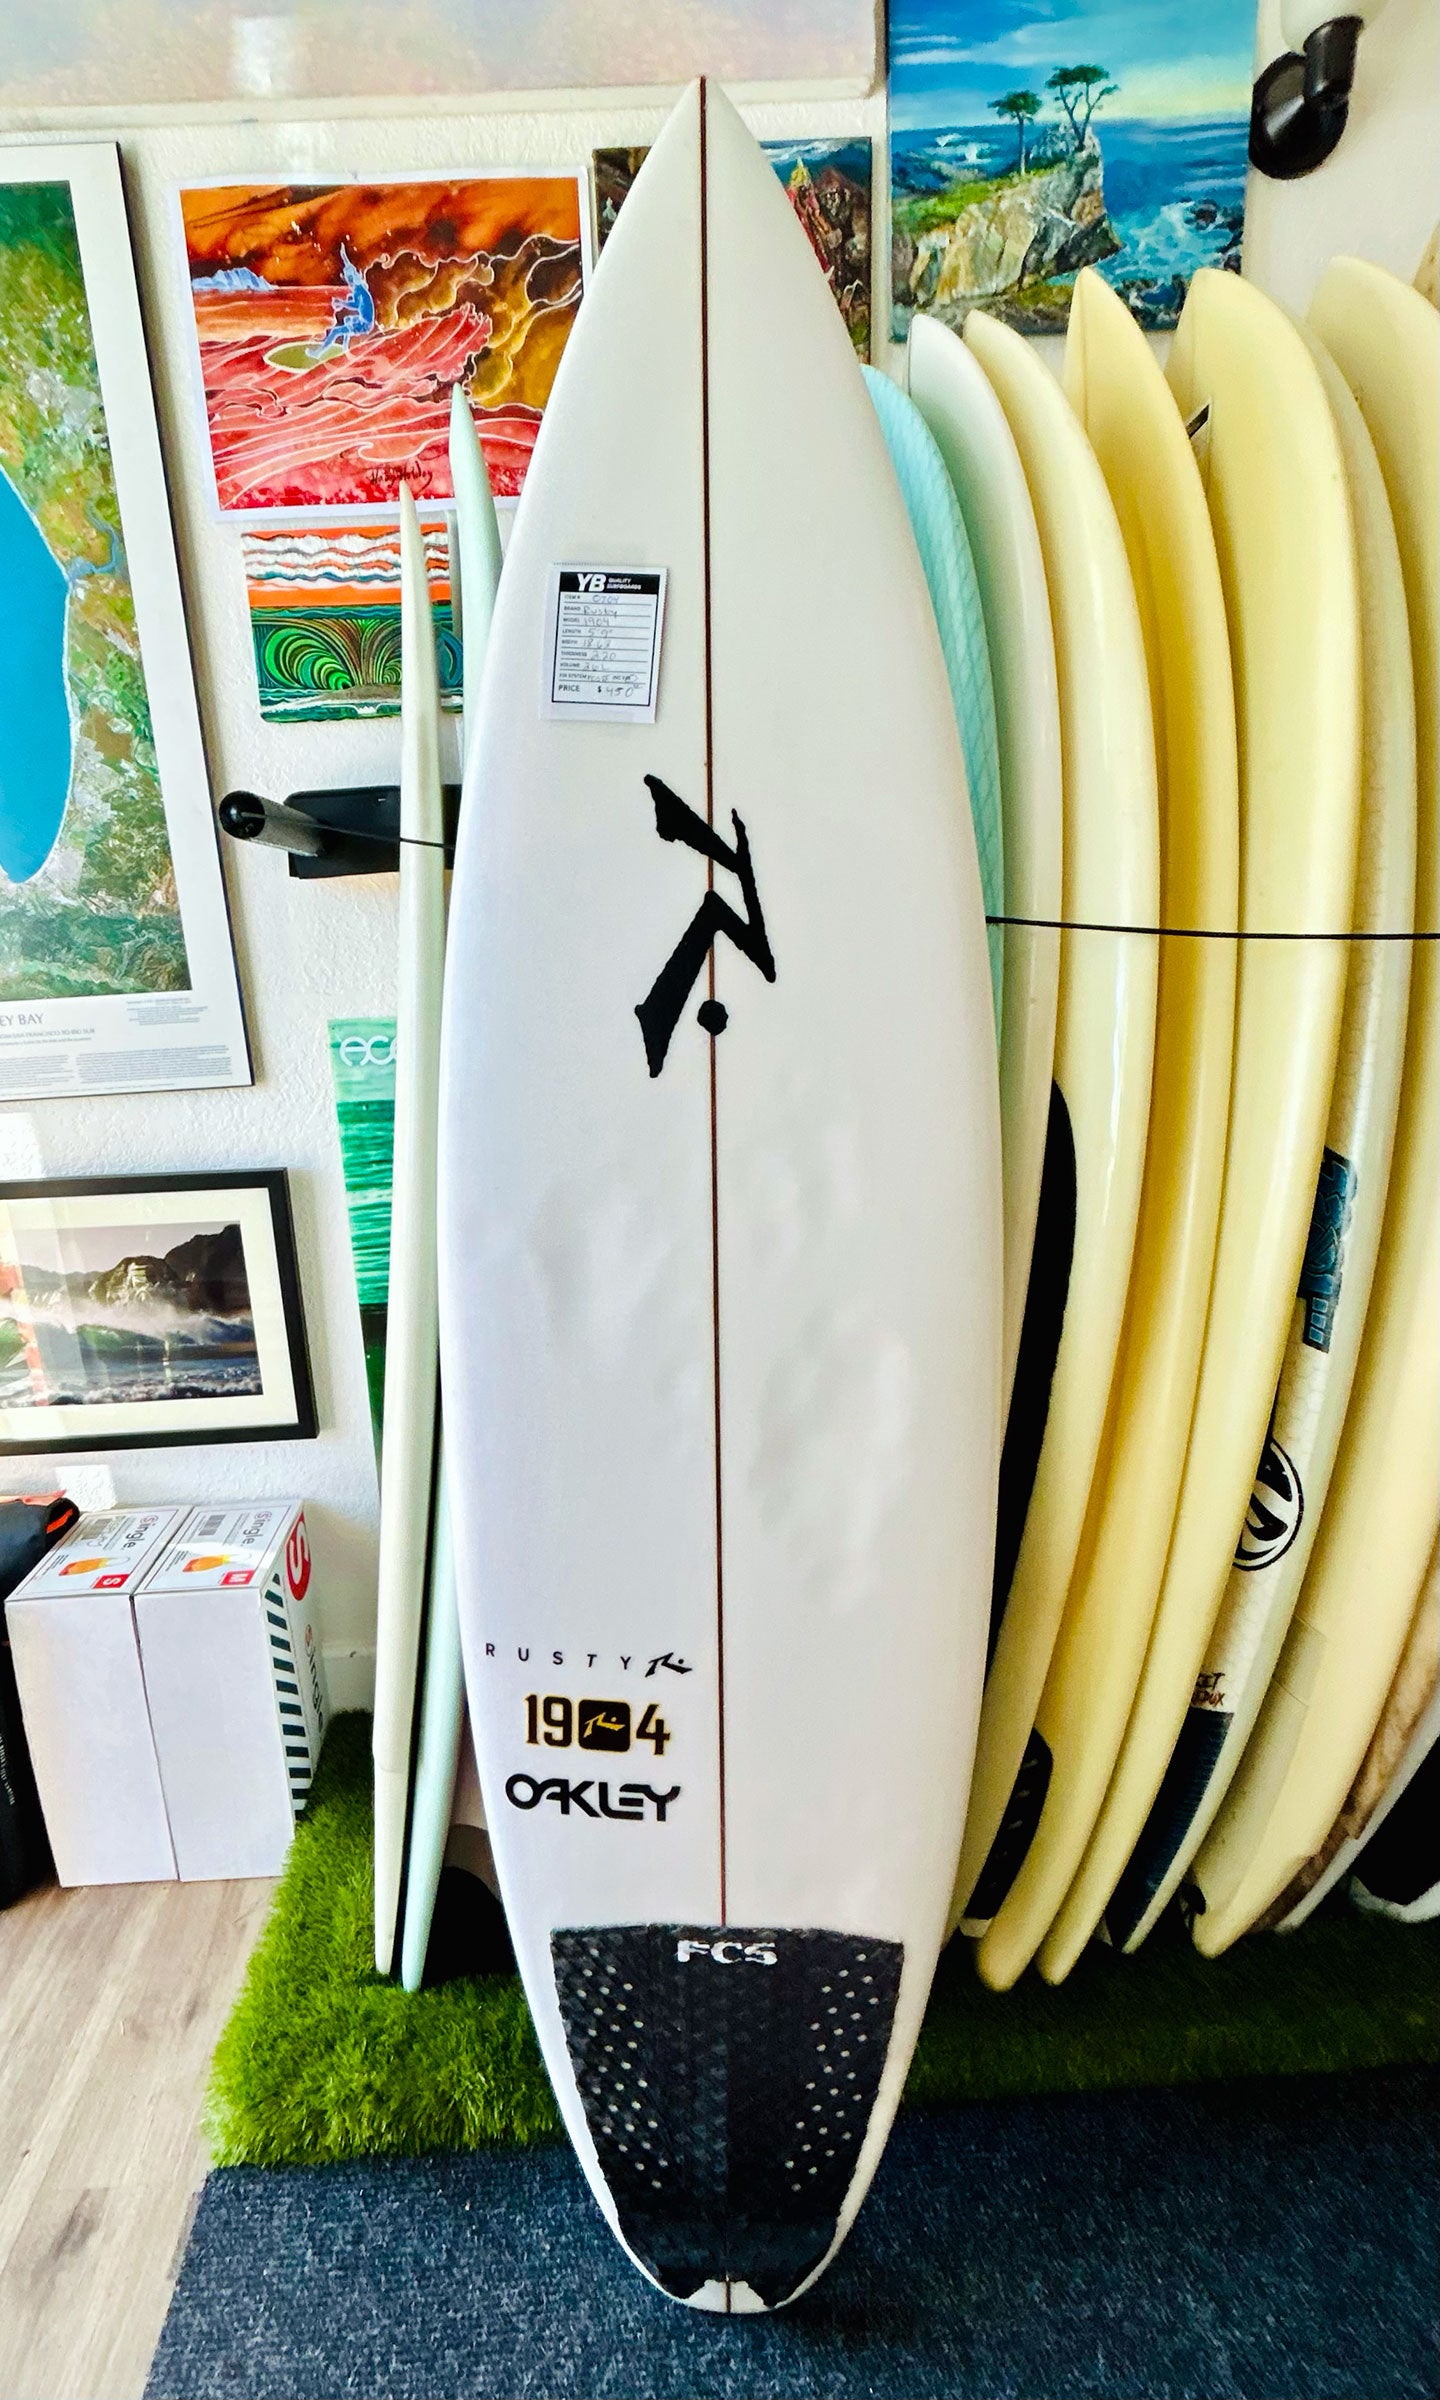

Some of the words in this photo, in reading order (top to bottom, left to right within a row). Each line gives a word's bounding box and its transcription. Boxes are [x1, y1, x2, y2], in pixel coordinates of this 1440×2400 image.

[577, 573, 607, 592] YB
[558, 684, 580, 692] PRICE
[17, 1013, 44, 1025] BAY
[102, 1577, 122, 1586] S
[228, 1573, 250, 1583] M
[485, 1642, 632, 1670] RUSTY
[505, 1773, 681, 1822] OAKLEY
[677, 1940, 778, 1965] FCS
